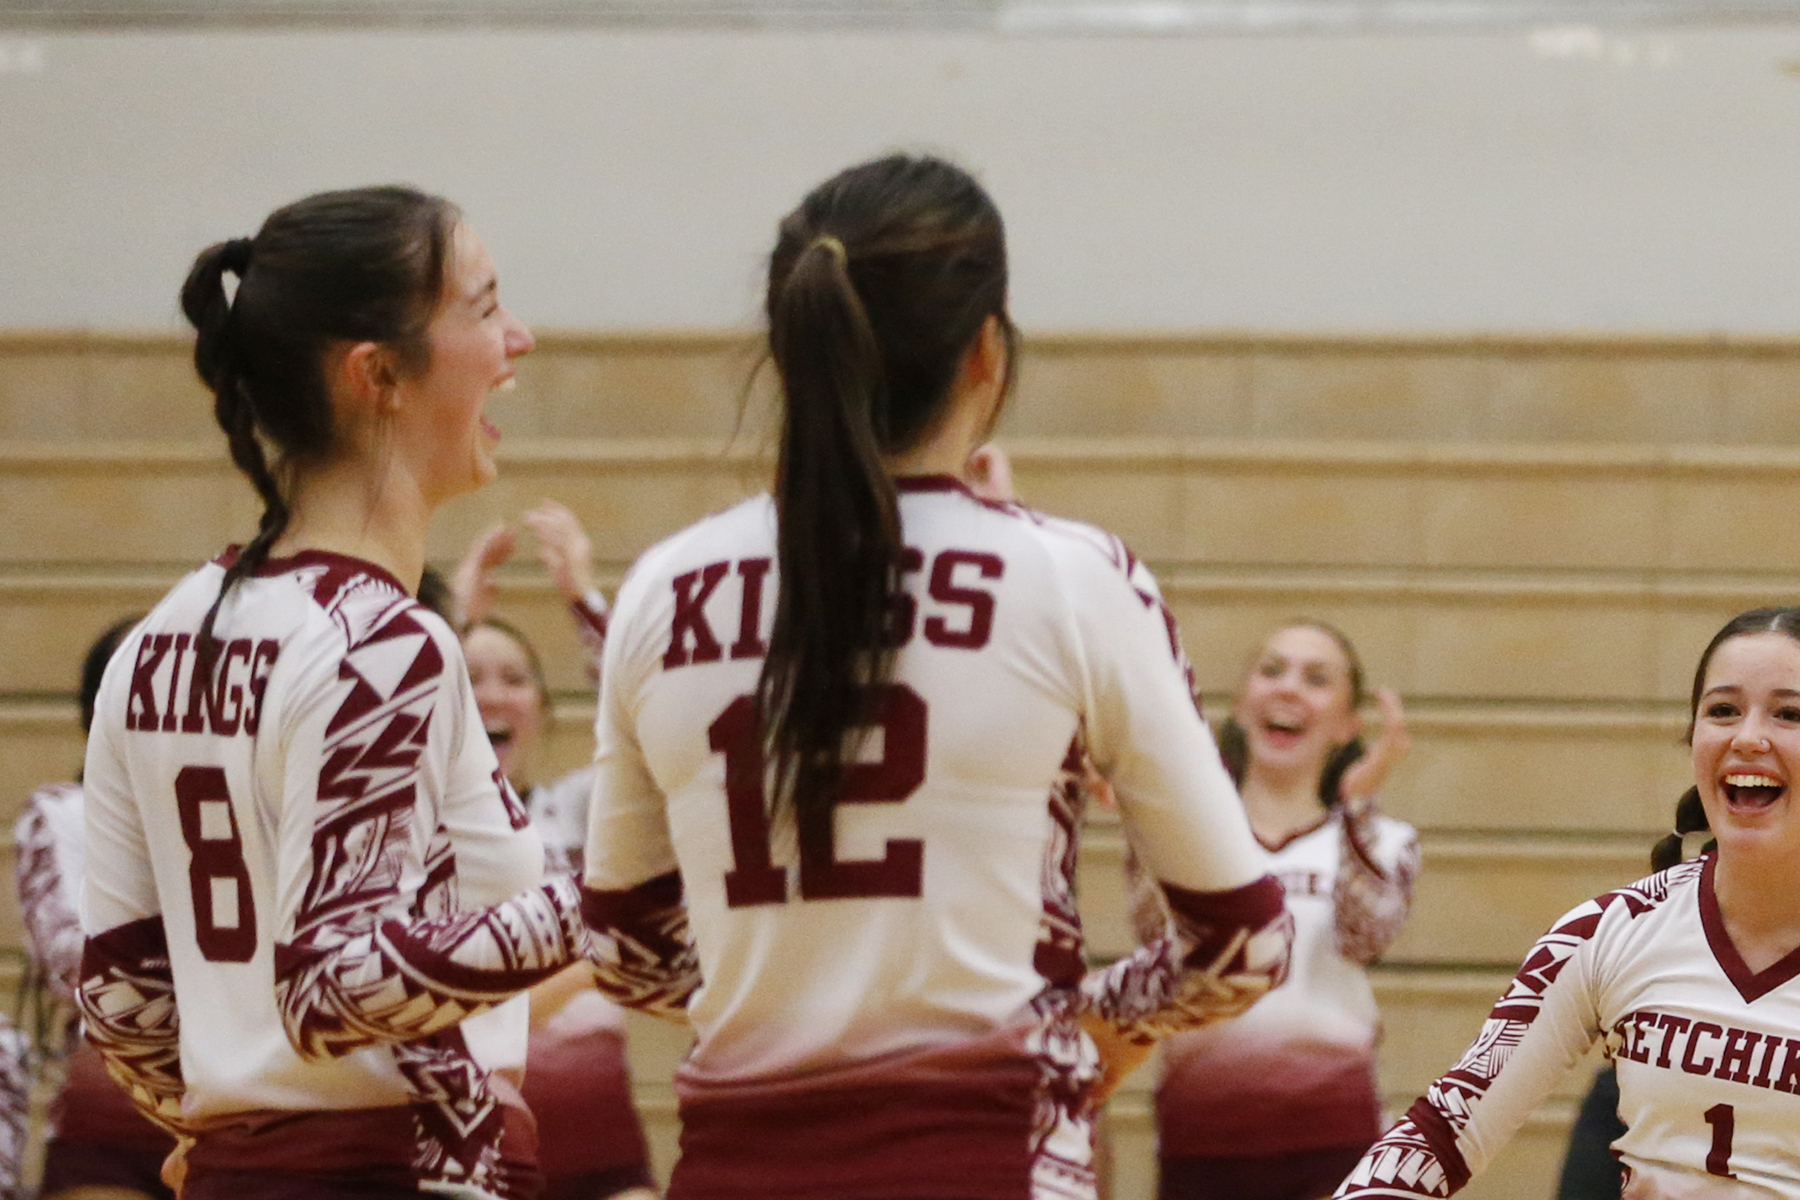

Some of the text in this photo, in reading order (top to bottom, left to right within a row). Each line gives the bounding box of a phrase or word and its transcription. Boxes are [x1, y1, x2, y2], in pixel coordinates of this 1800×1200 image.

[663, 547, 1004, 671] KIS
[126, 633, 279, 737] KINGS
[708, 682, 928, 908] 12
[175, 765, 257, 963] 8
[1704, 1103, 1737, 1179] 1
